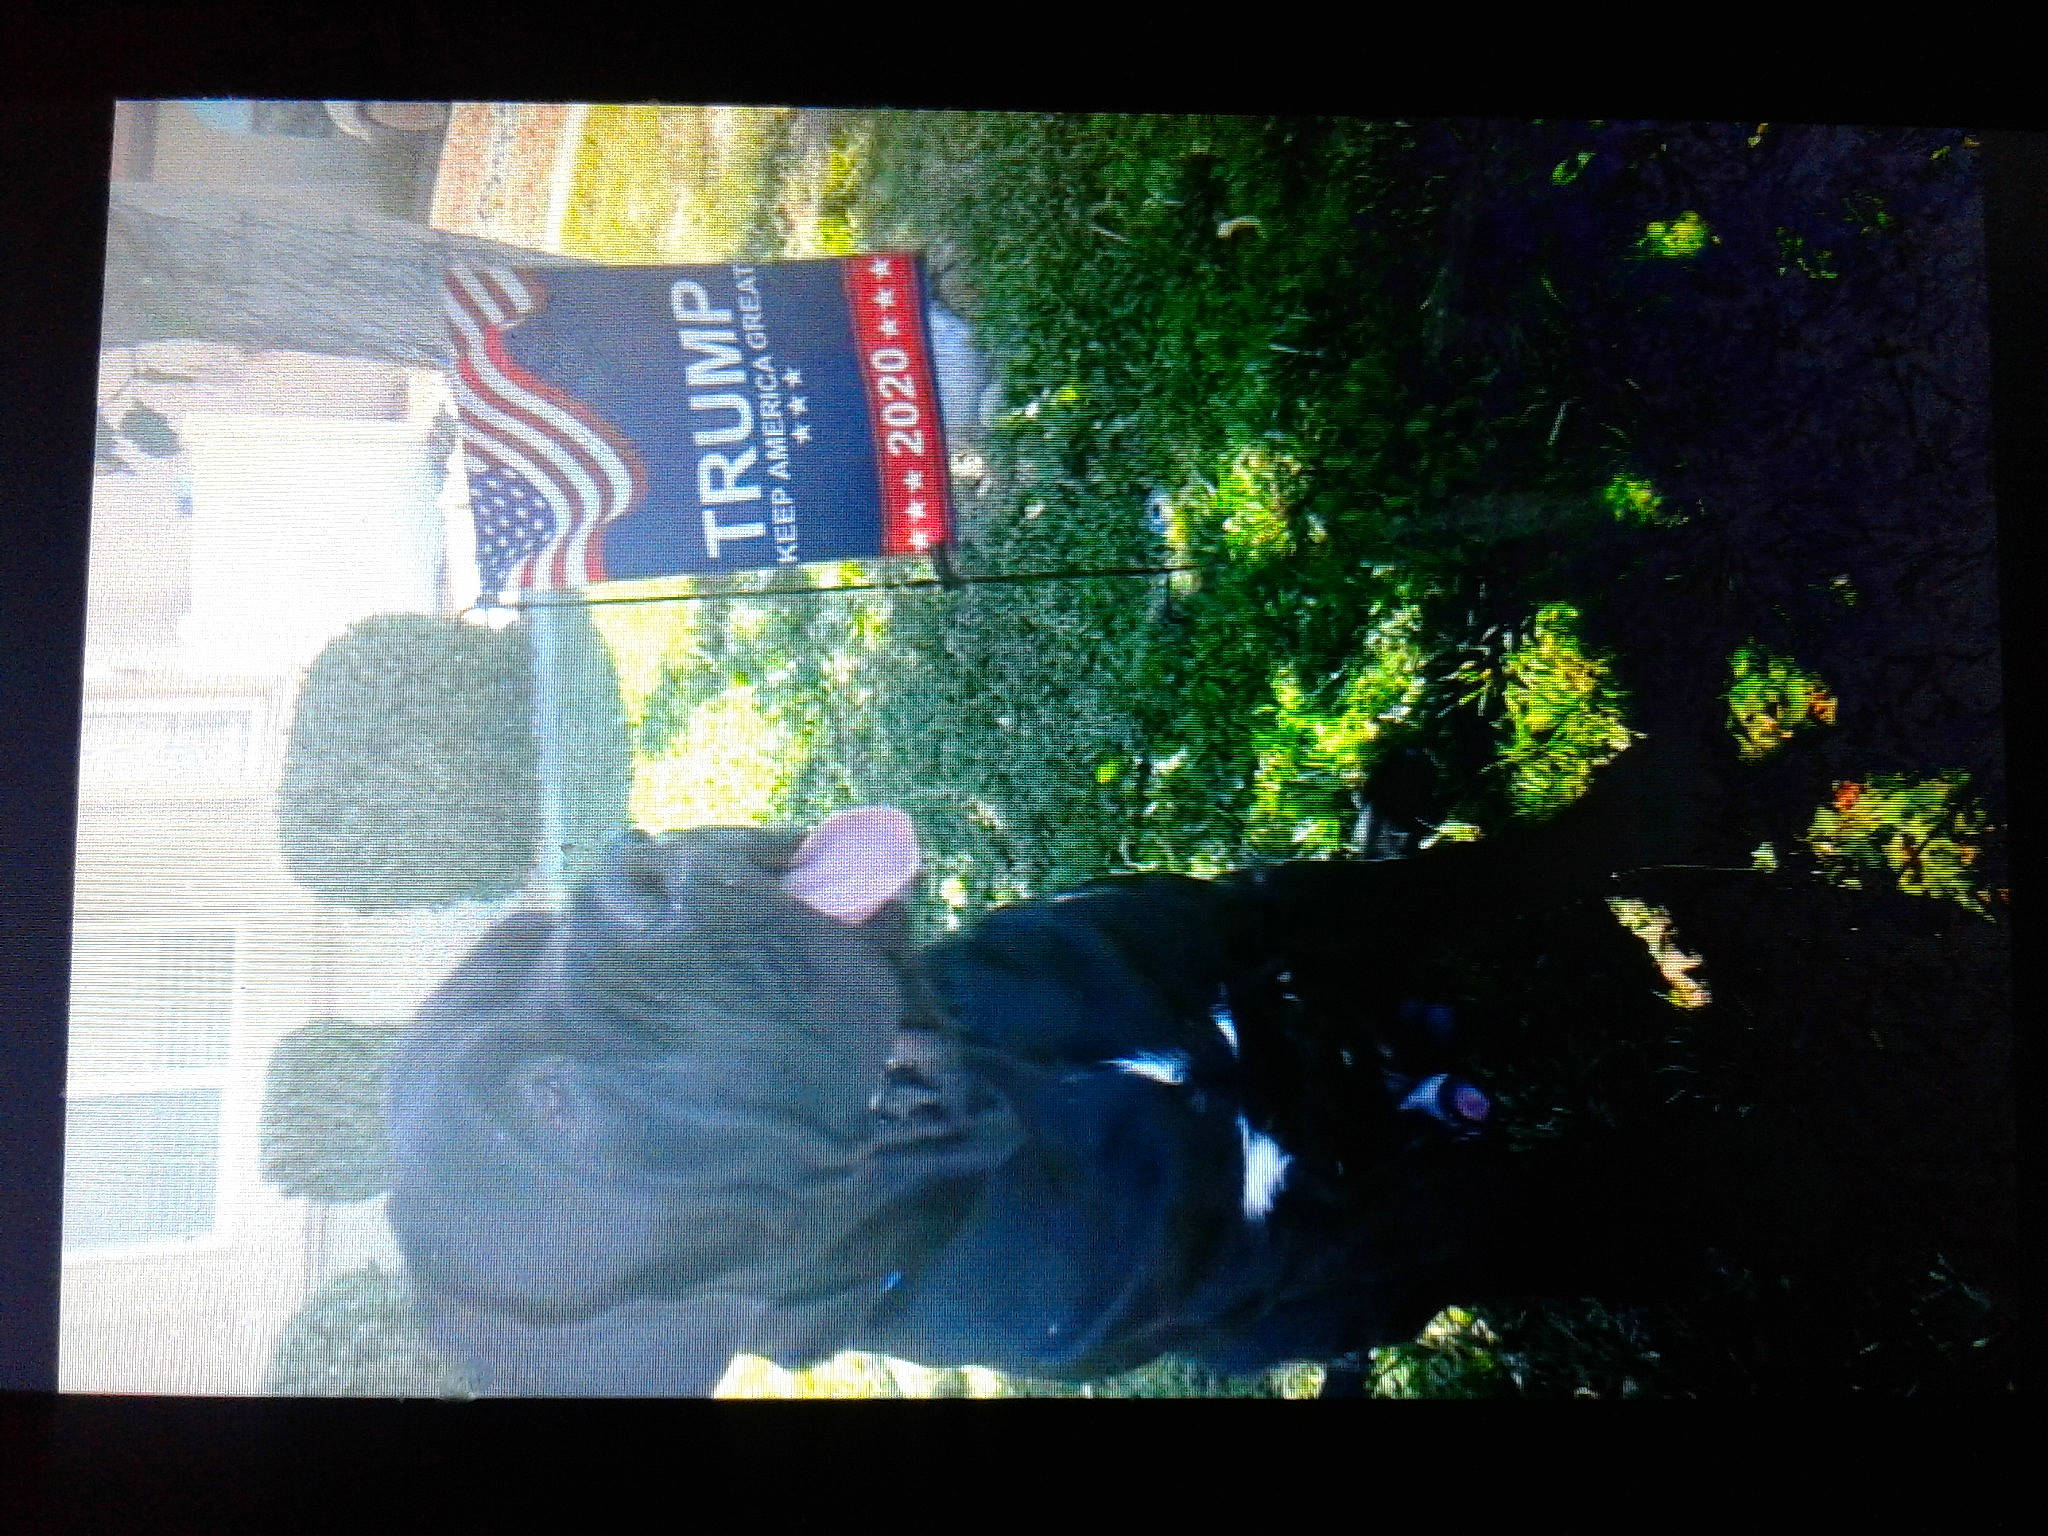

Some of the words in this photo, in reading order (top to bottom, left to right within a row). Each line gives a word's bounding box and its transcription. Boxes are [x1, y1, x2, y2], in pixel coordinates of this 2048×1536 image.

[732, 263, 768, 350] GREAT
[671, 280, 766, 558] TRUMP
[753, 356, 791, 480] AMERICA
[871, 347, 925, 456] 2020
[771, 488, 798, 564] KEEP
